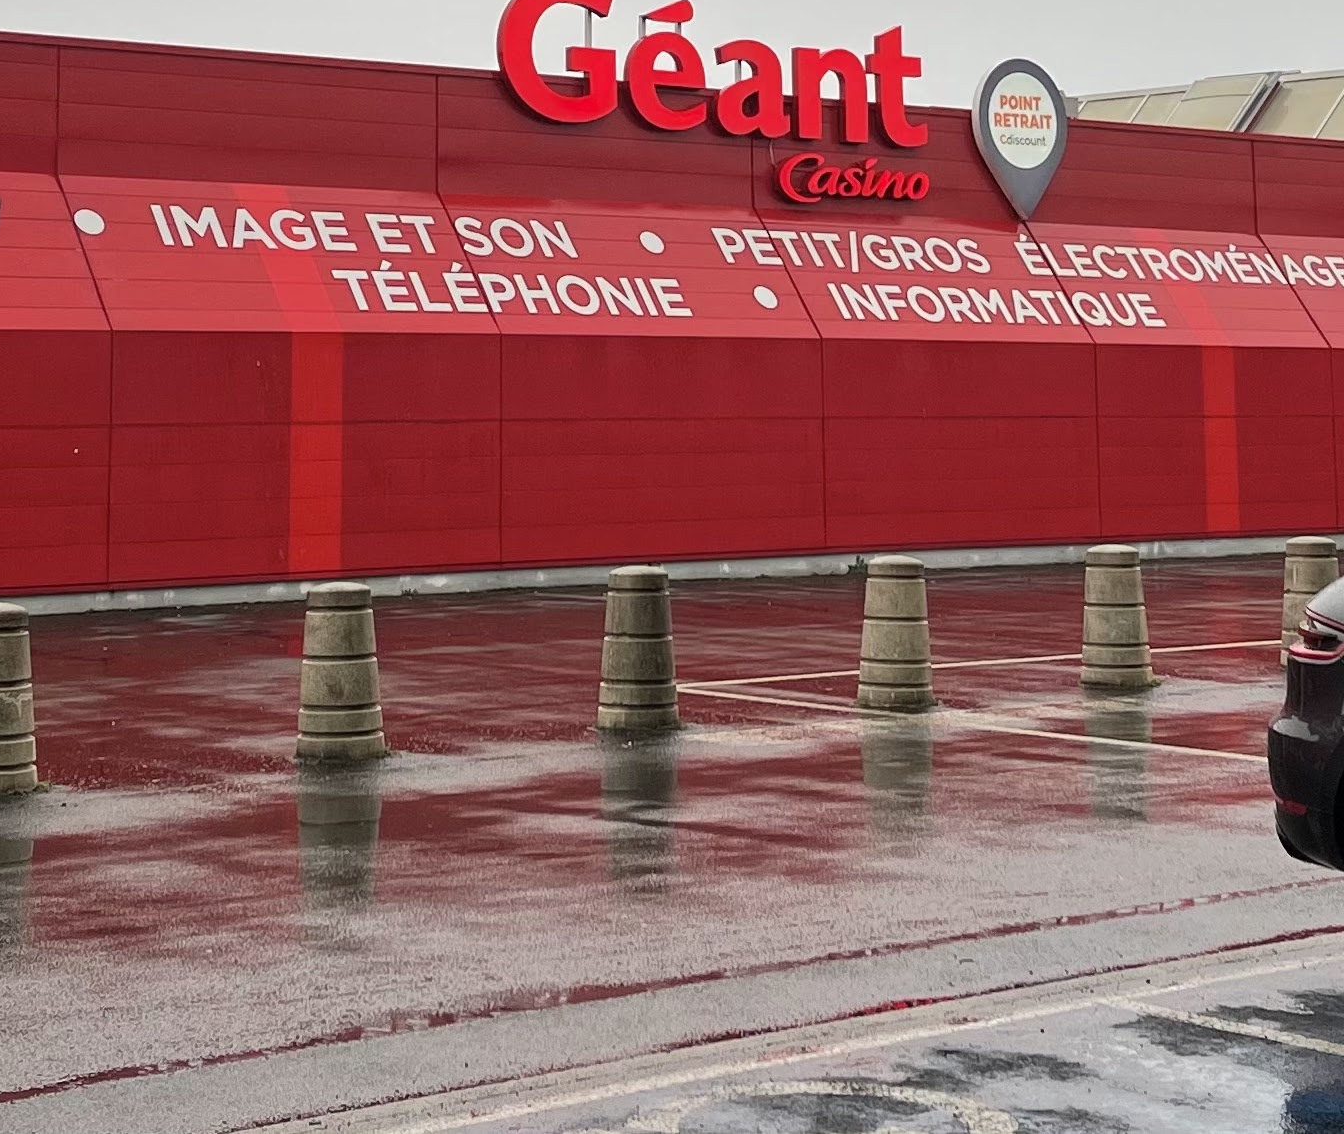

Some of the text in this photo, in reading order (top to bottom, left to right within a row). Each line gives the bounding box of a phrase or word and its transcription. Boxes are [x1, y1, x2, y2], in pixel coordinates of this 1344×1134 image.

[999, 94, 1042, 112] POINT
[993, 112, 1052, 130] RETRAIT
[999, 133, 1047, 147] Cdiscount
[778, 153, 930, 203] Casino
[149, 204, 357, 252] IMAGE
[364, 212, 436, 254] ET
[454, 216, 580, 259] SON
[710, 227, 991, 274] PETIT/GROS
[332, 260, 1167, 328] TÉLÉPHONIE INFORMATIQUE
